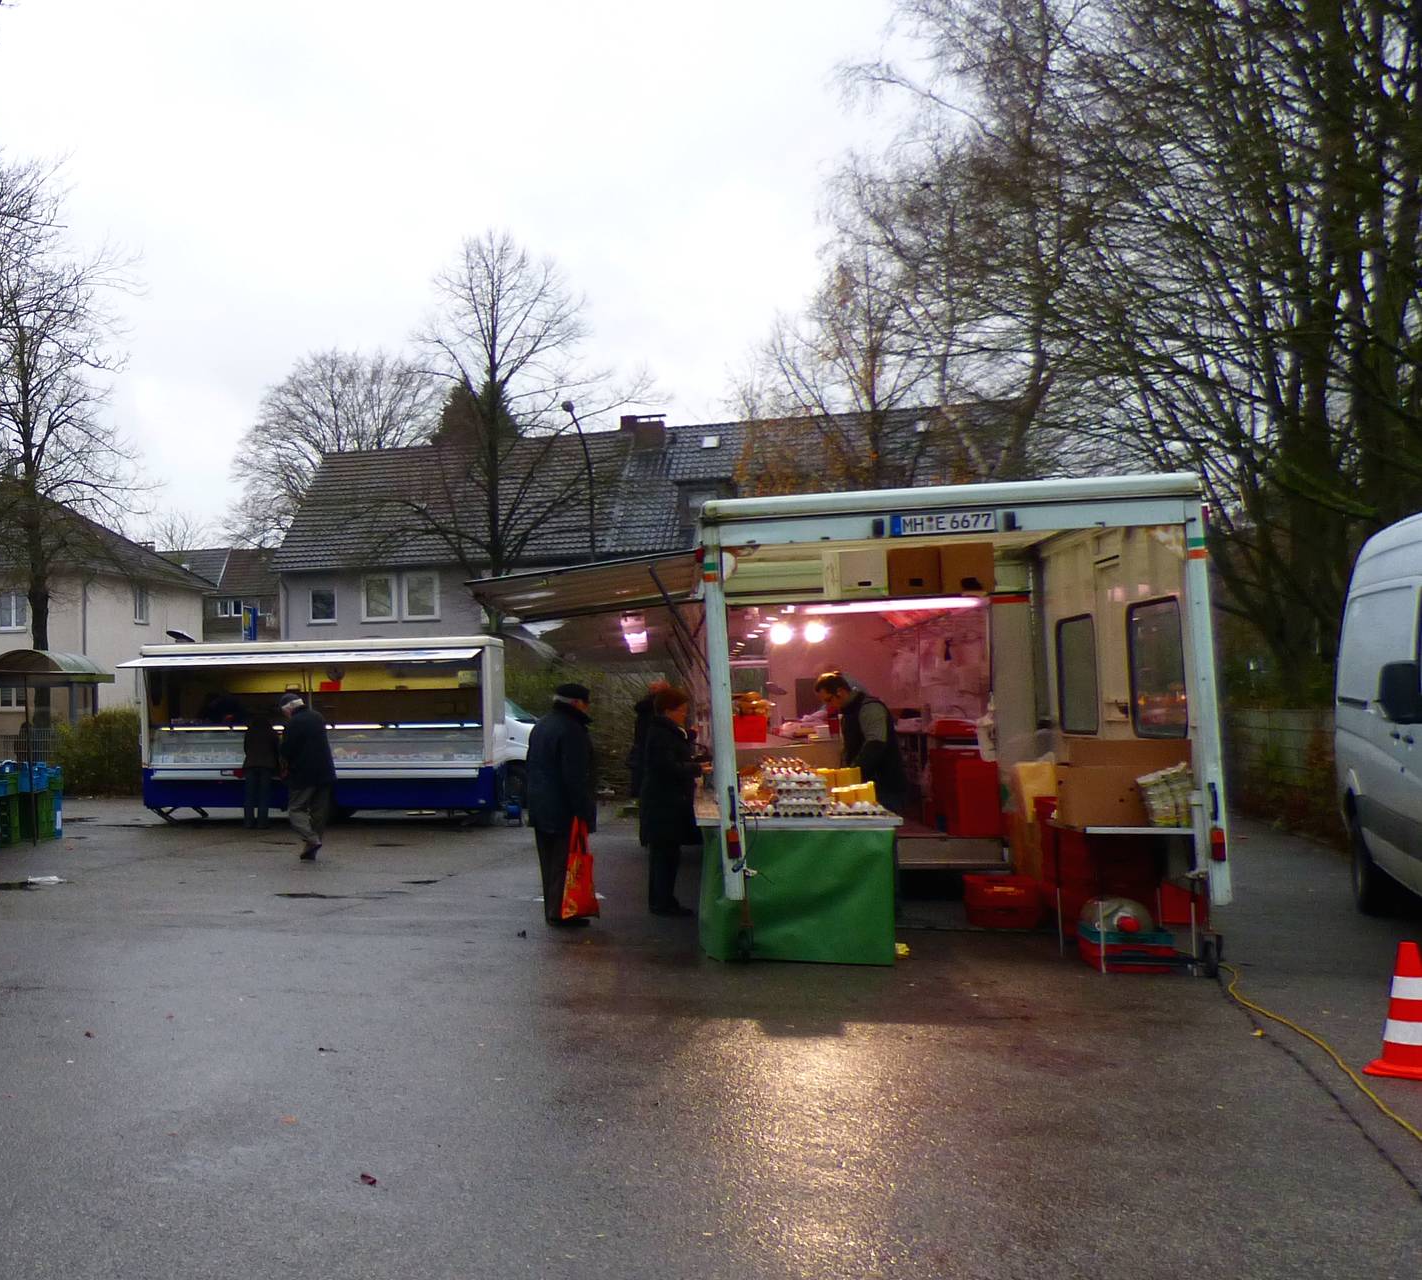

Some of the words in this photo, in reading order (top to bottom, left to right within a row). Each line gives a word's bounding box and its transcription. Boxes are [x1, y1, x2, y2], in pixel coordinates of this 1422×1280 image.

[902, 517, 924, 532] MH
[935, 515, 946, 530] E
[950, 513, 992, 529] 6677
